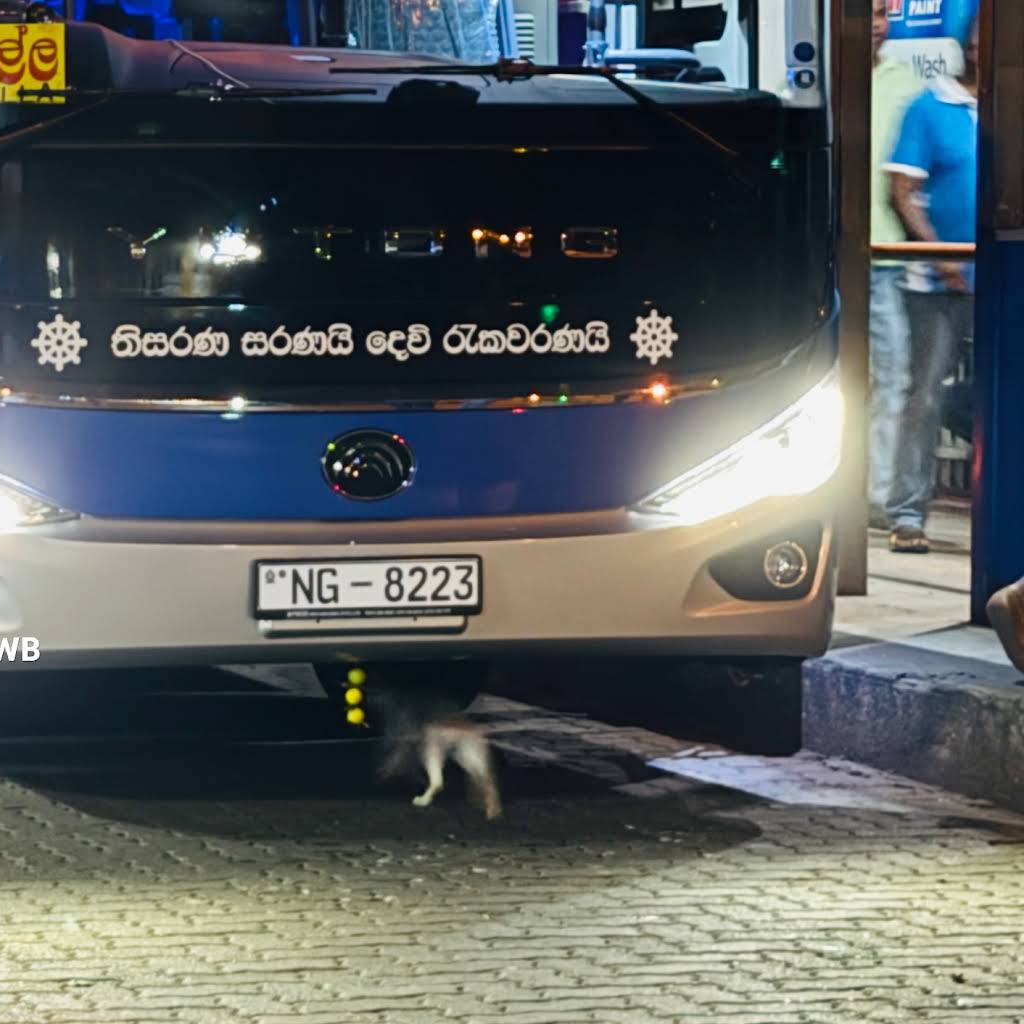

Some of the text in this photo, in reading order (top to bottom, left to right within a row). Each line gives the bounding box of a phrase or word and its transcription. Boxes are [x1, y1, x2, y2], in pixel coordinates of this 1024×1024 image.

[908, 0, 943, 16] PAINT
[912, 54, 947, 79] Wash
[110, 321, 610, 361] තිසරණ සරණයි දෙවි රැකවරණයි
